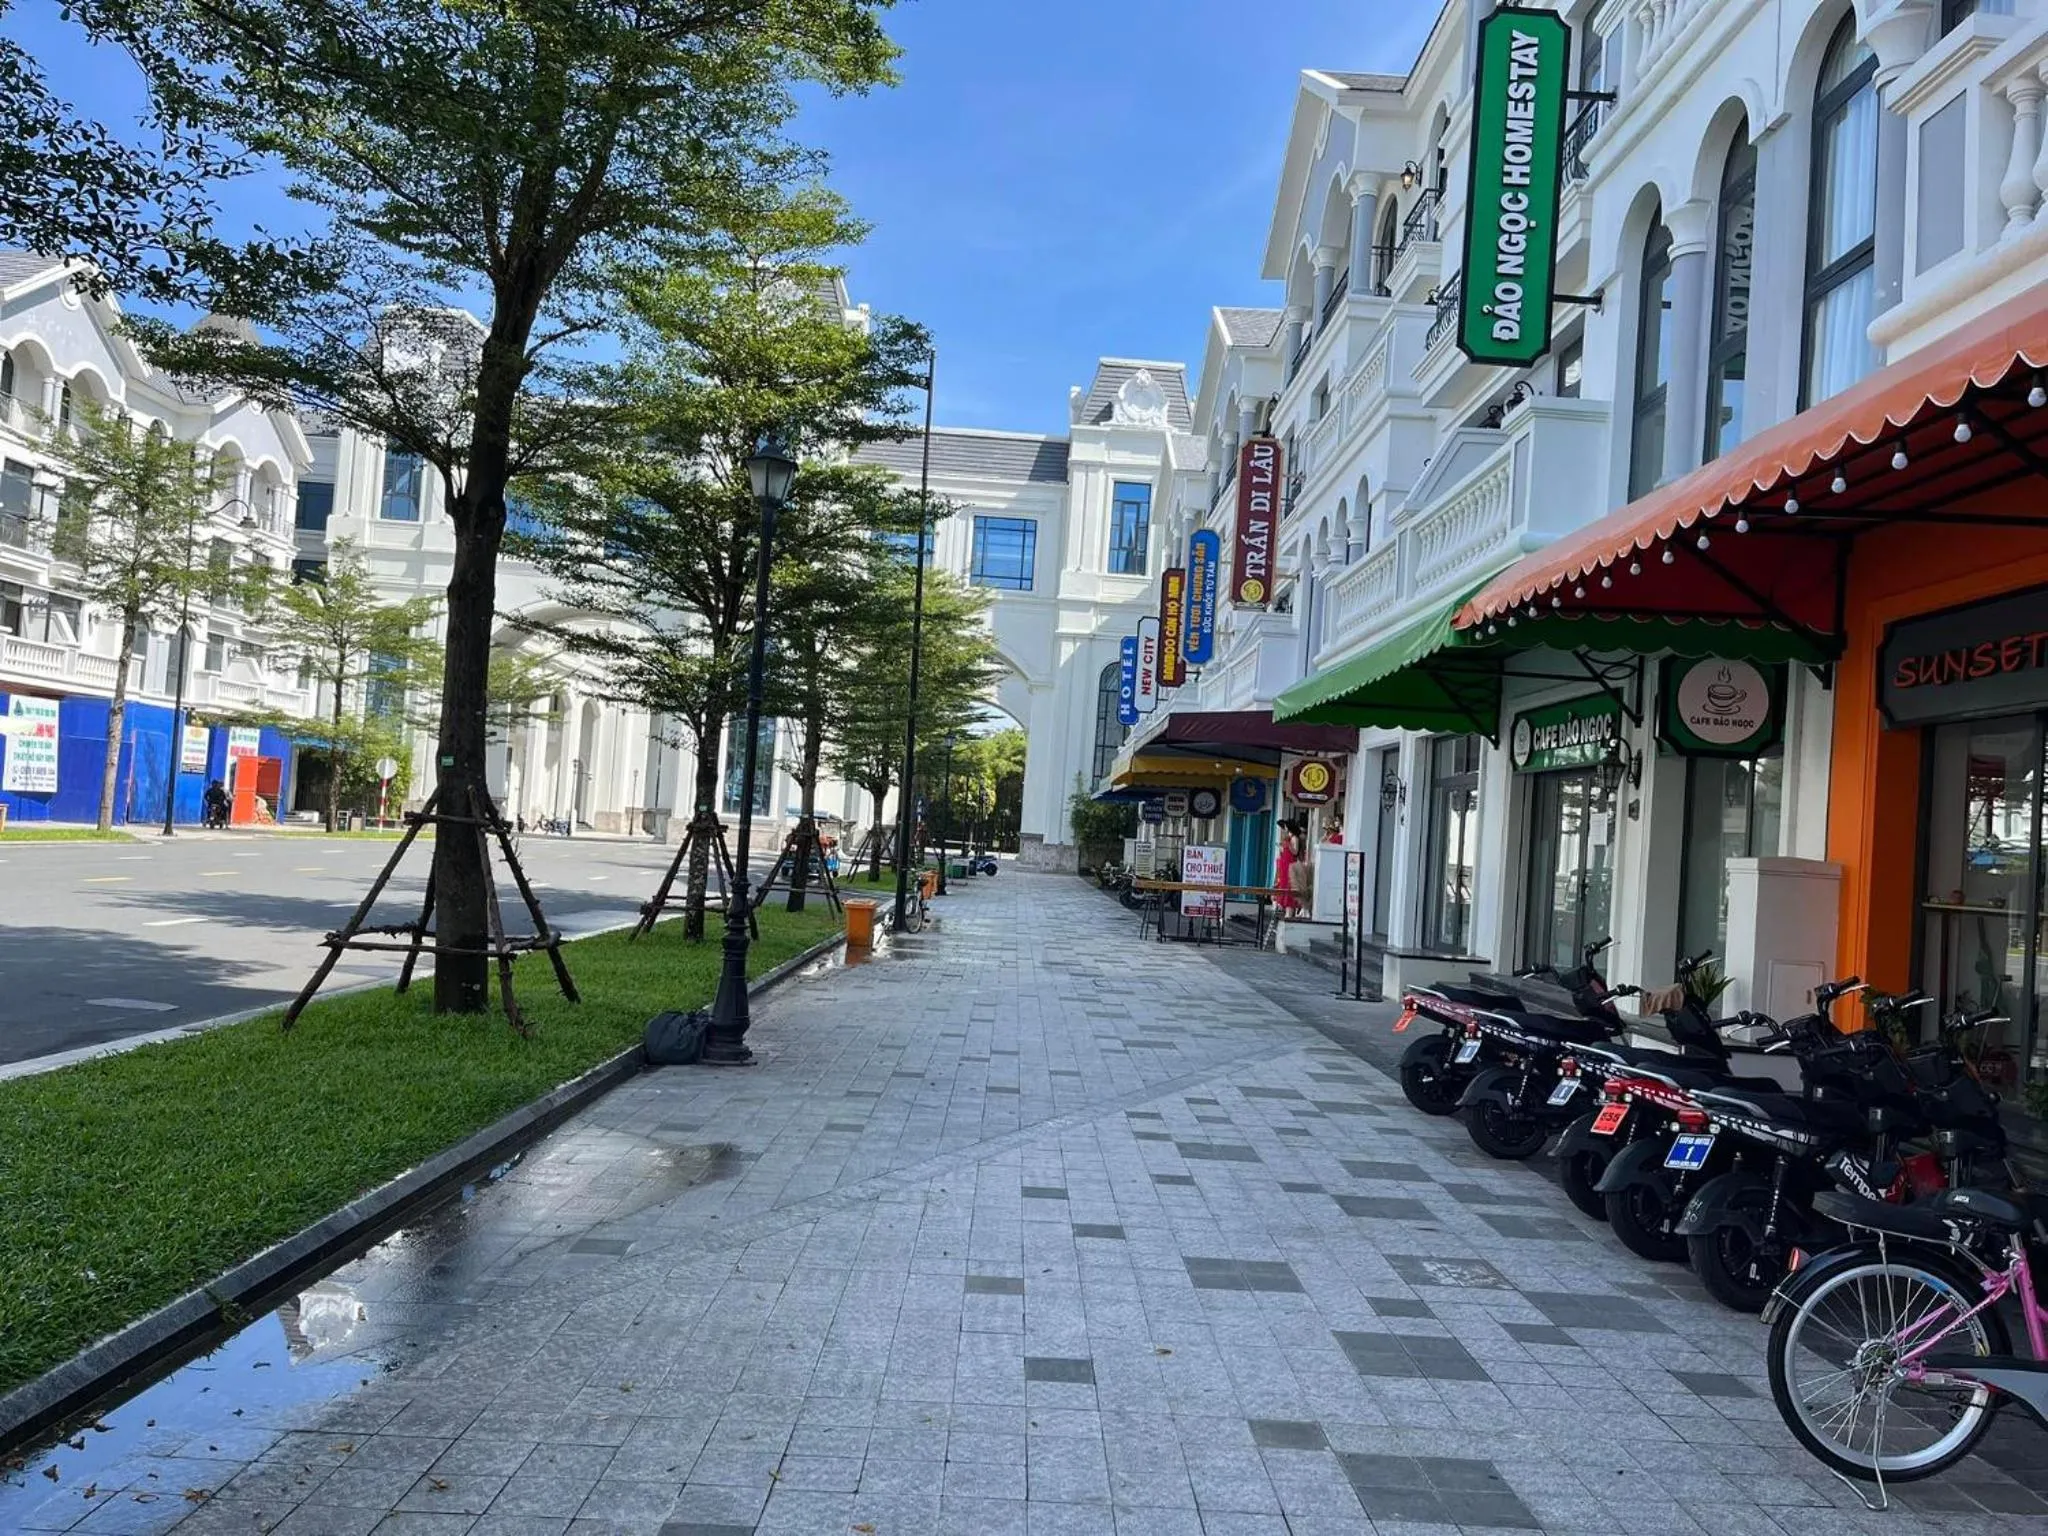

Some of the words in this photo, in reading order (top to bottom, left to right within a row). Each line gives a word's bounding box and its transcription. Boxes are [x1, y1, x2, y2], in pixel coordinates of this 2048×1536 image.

[1502, 30, 1541, 186] HOMESTAY
[1496, 191, 1538, 277] NGỌC
[1482, 283, 1524, 344] ĐẢO
[1250, 492, 1271, 512] DI
[1143, 636, 1155, 664] CITY
[1893, 631, 2048, 689] SUNSET
[1120, 647, 1133, 716] HOTEL
[1141, 669, 1152, 696] NEW
[1690, 716, 1711, 726] CAFE
[1533, 725, 1558, 752] CAFE
[1186, 862, 1202, 873] CHO
[1684, 1145, 1696, 1160] 1
